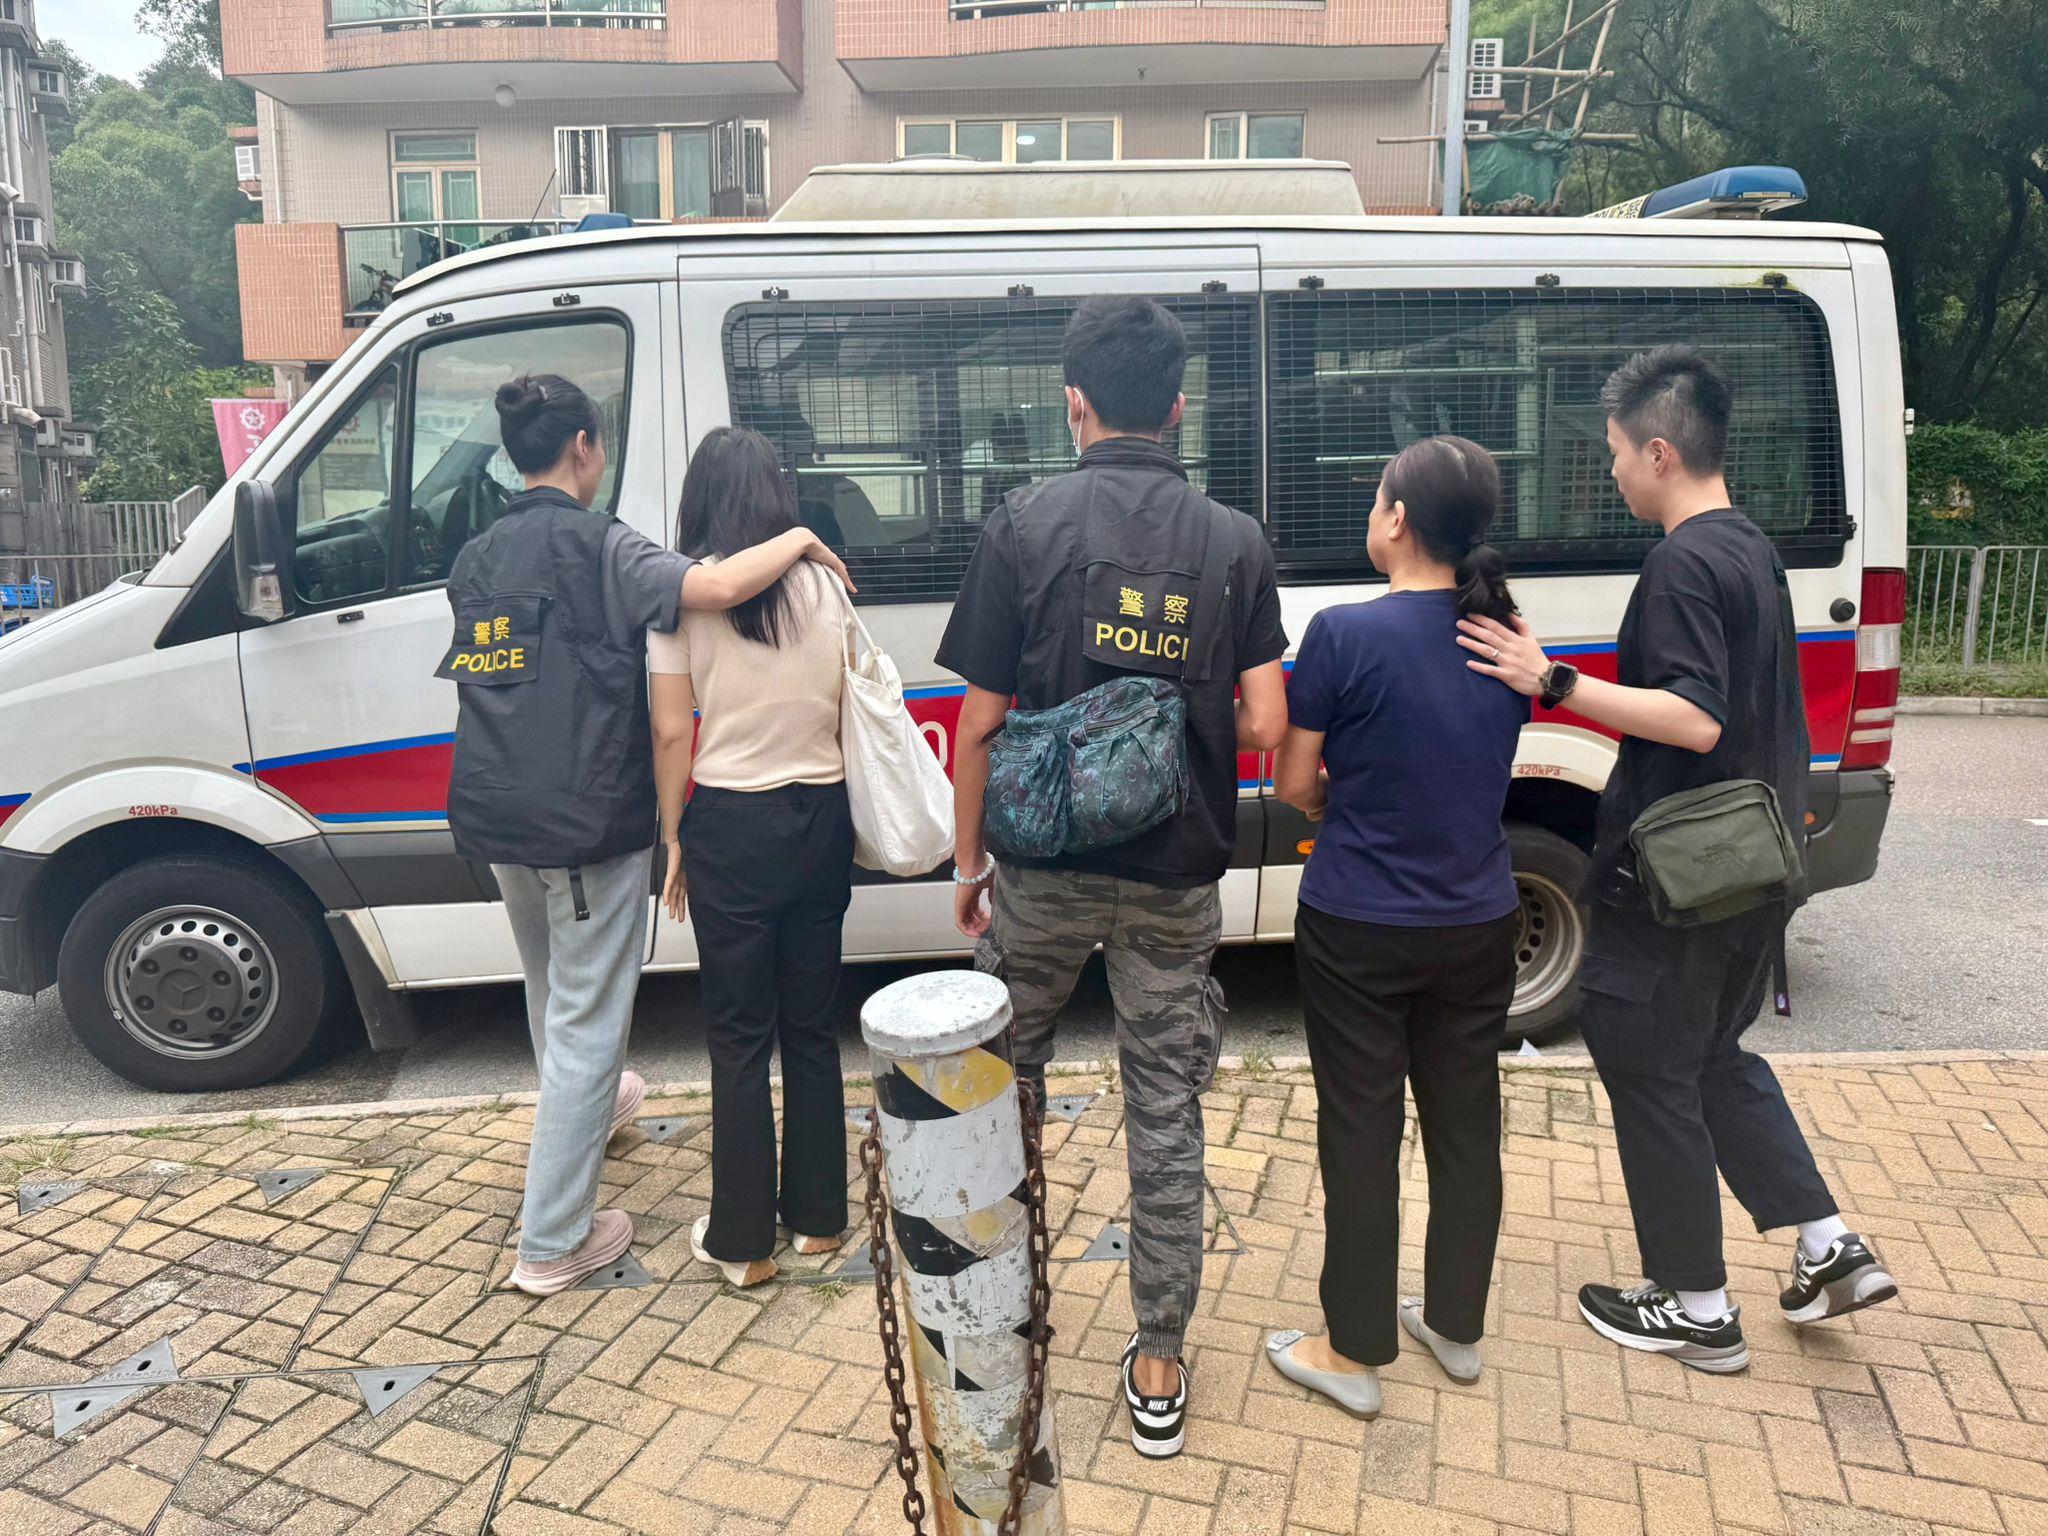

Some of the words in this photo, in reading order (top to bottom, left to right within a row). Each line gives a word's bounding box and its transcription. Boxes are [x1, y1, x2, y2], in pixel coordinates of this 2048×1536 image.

[1119, 586, 1189, 624] 警察
[473, 616, 510, 645] 警察
[451, 647, 525, 672] POLICE
[1517, 765, 1561, 777] 420kPa
[128, 805, 179, 817] 420kPa
[1147, 1400, 1170, 1411] NIKE
